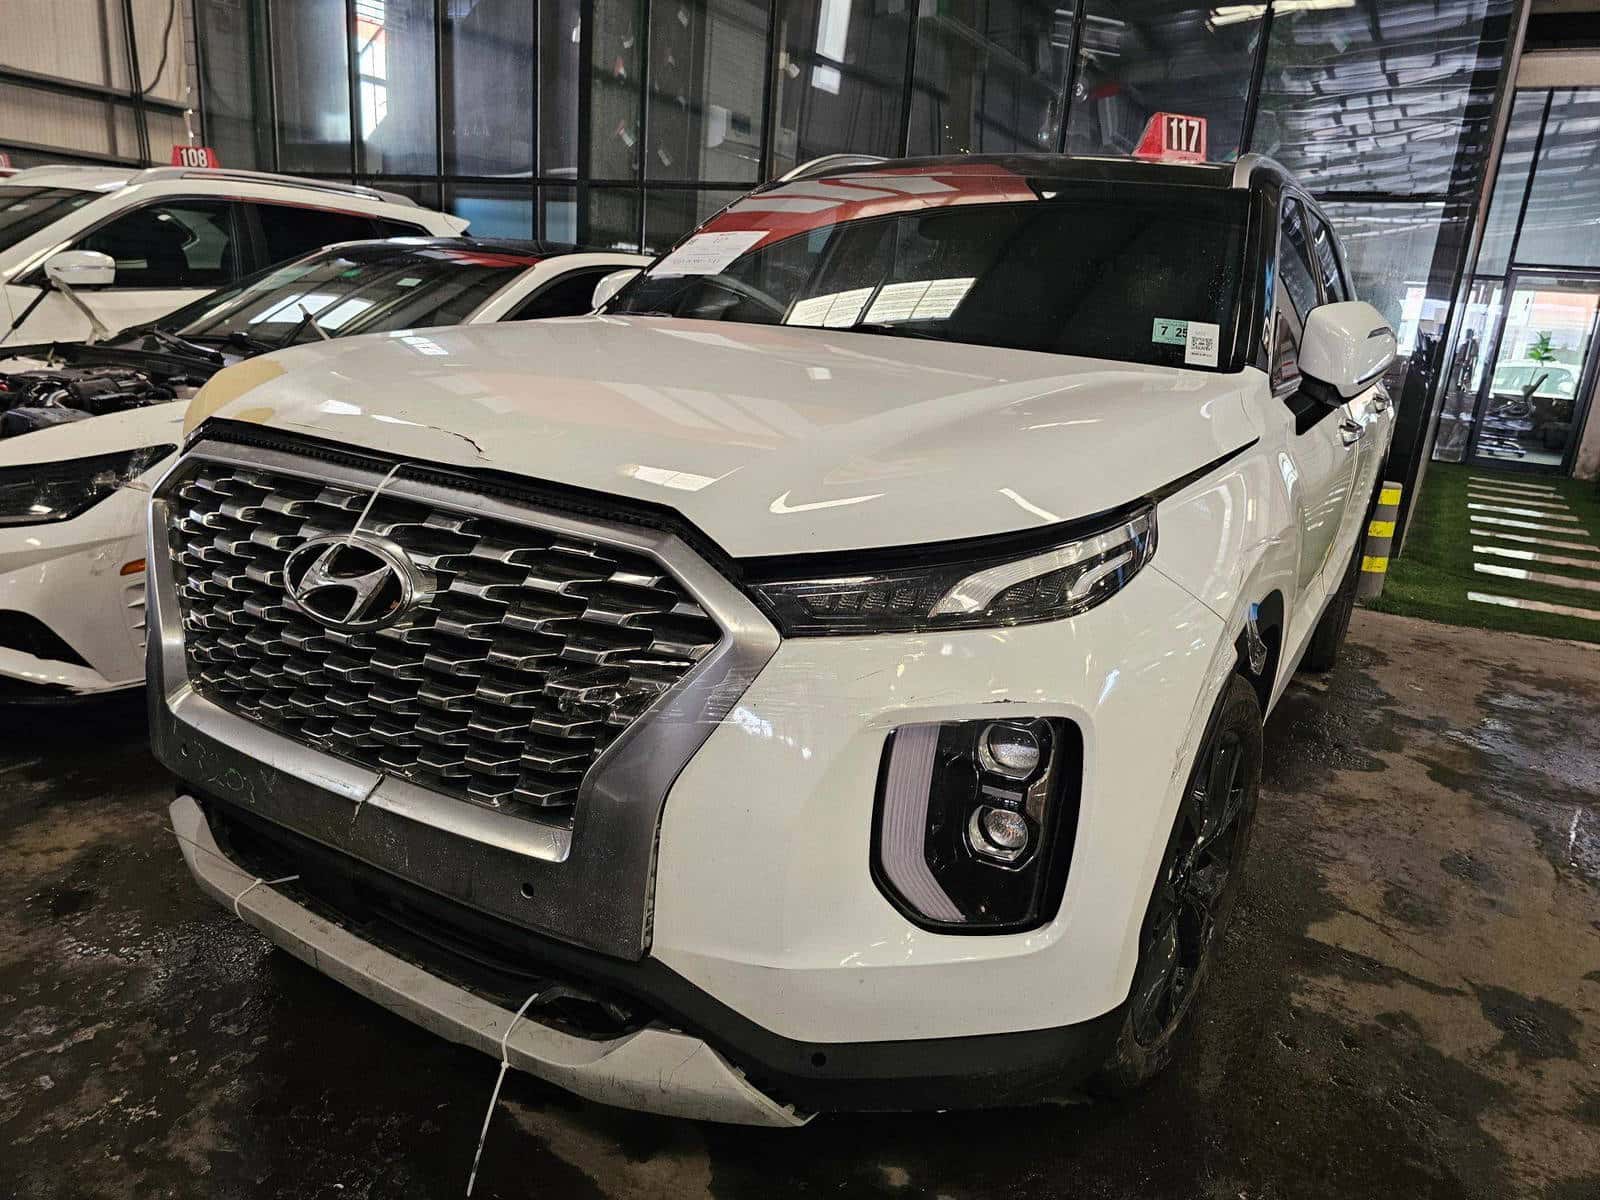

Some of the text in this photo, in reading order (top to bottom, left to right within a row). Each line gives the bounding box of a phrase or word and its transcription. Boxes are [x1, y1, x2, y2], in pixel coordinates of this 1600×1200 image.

[1170, 118, 1200, 152] 117
[180, 148, 208, 167] 108
[1161, 326, 1169, 336] 7
[1175, 328, 1188, 338] 25
